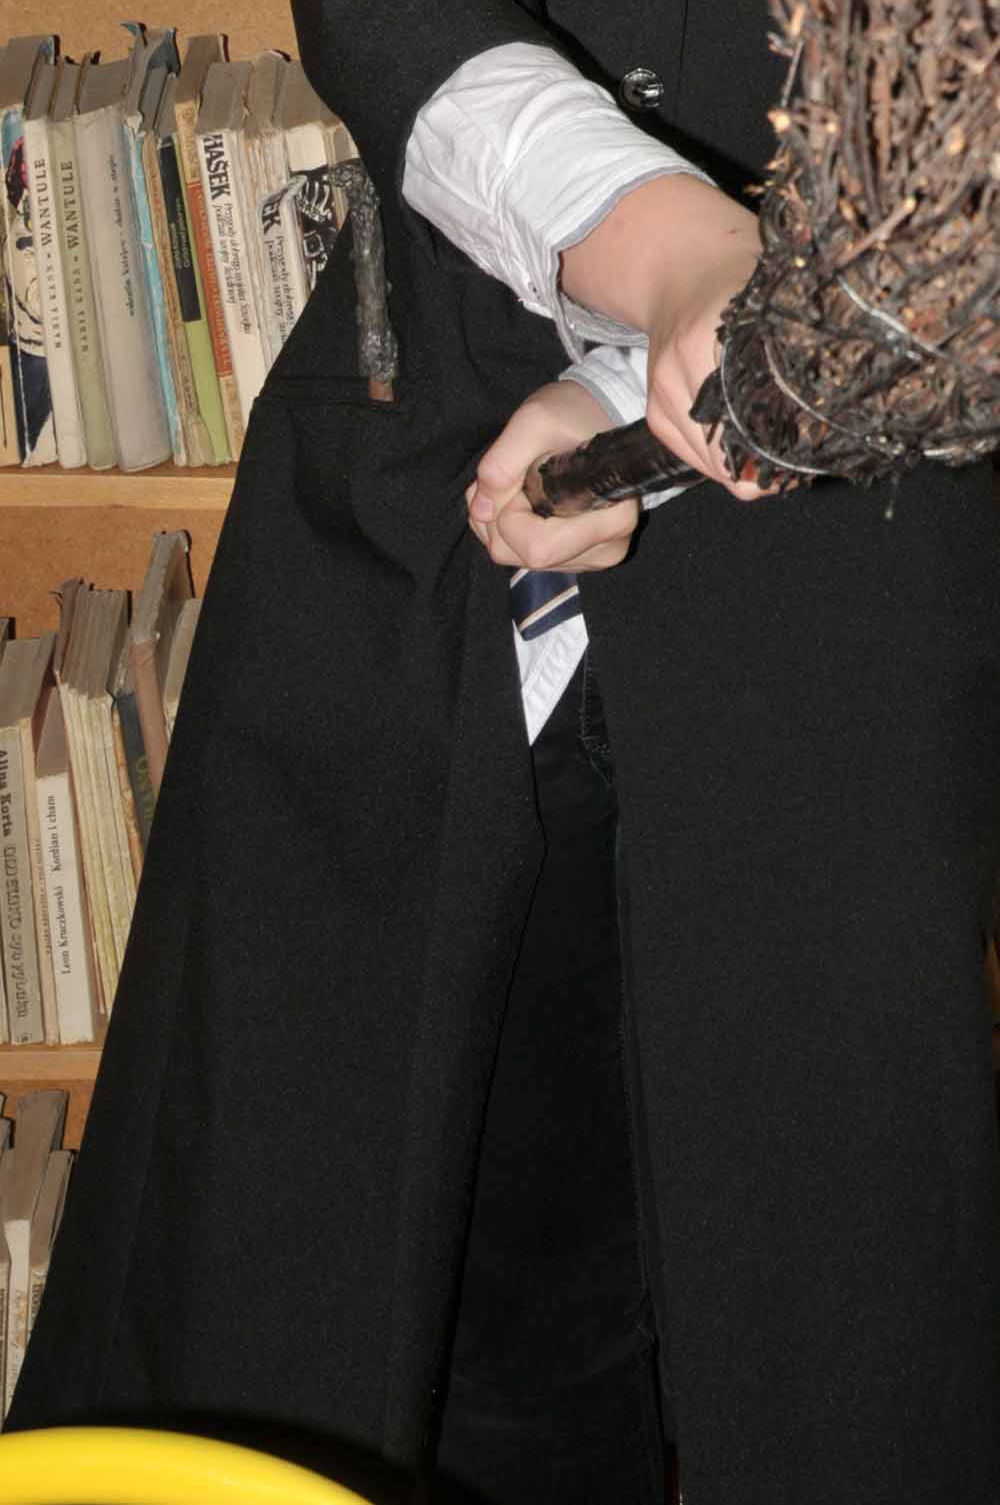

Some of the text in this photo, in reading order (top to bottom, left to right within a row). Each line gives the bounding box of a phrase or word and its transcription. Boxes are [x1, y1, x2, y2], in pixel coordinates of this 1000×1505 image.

[203, 133, 231, 200] HAŠEK
[34, 157, 54, 247] WANTULE
[60, 160, 81, 250] WANTULE
[44, 795, 56, 823] cham
[48, 833, 62, 872] Kordian
[53, 886, 68, 947] Kruczkowski
[60, 950, 72, 974] Leon
